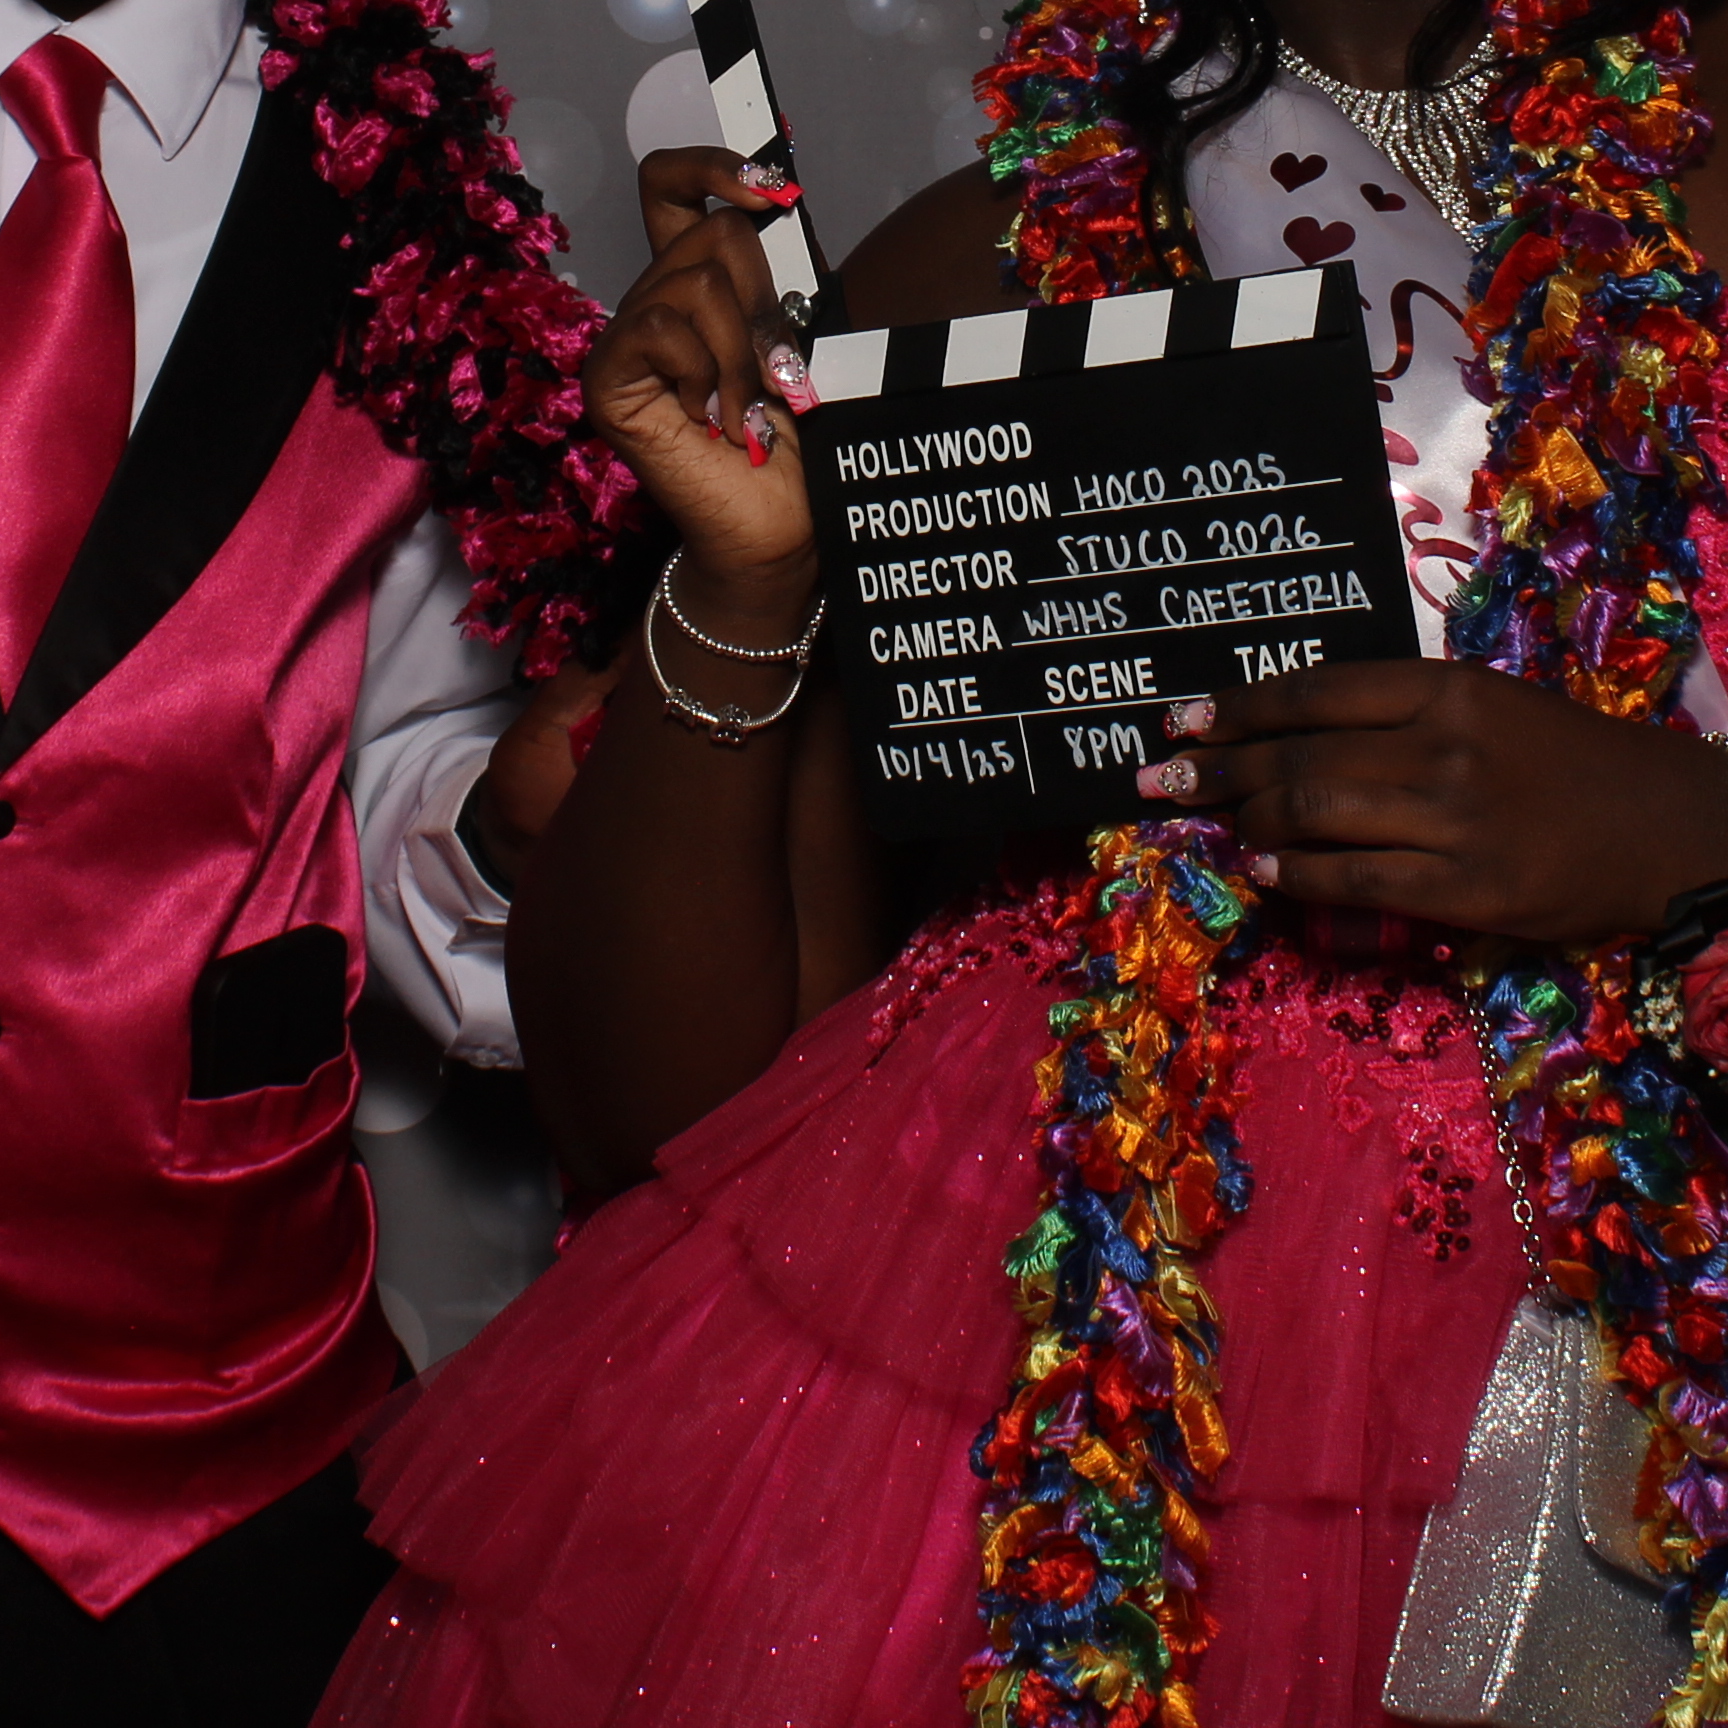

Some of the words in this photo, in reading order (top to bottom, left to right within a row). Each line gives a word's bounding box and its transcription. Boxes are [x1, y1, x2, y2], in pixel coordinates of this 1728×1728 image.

[836, 421, 1032, 482] HOLLYWOOD
[846, 481, 1052, 542] PRODUCTION
[1074, 468, 1165, 512] HOCO
[1183, 453, 1286, 501] 2025
[857, 549, 1018, 603] DIRECTOR
[1058, 529, 1188, 575] STUCO
[1206, 513, 1321, 557] 2026
[869, 614, 1003, 664] CAMERA
[1022, 591, 1128, 637] WHHS
[1160, 570, 1373, 628] CAFETERIA
[896, 676, 982, 720] DATE
[1044, 657, 1158, 705] SCENE
[1233, 638, 1324, 684] TAKE
[877, 738, 1015, 784] 10/4/25
[1064, 722, 1146, 769] 8PM
